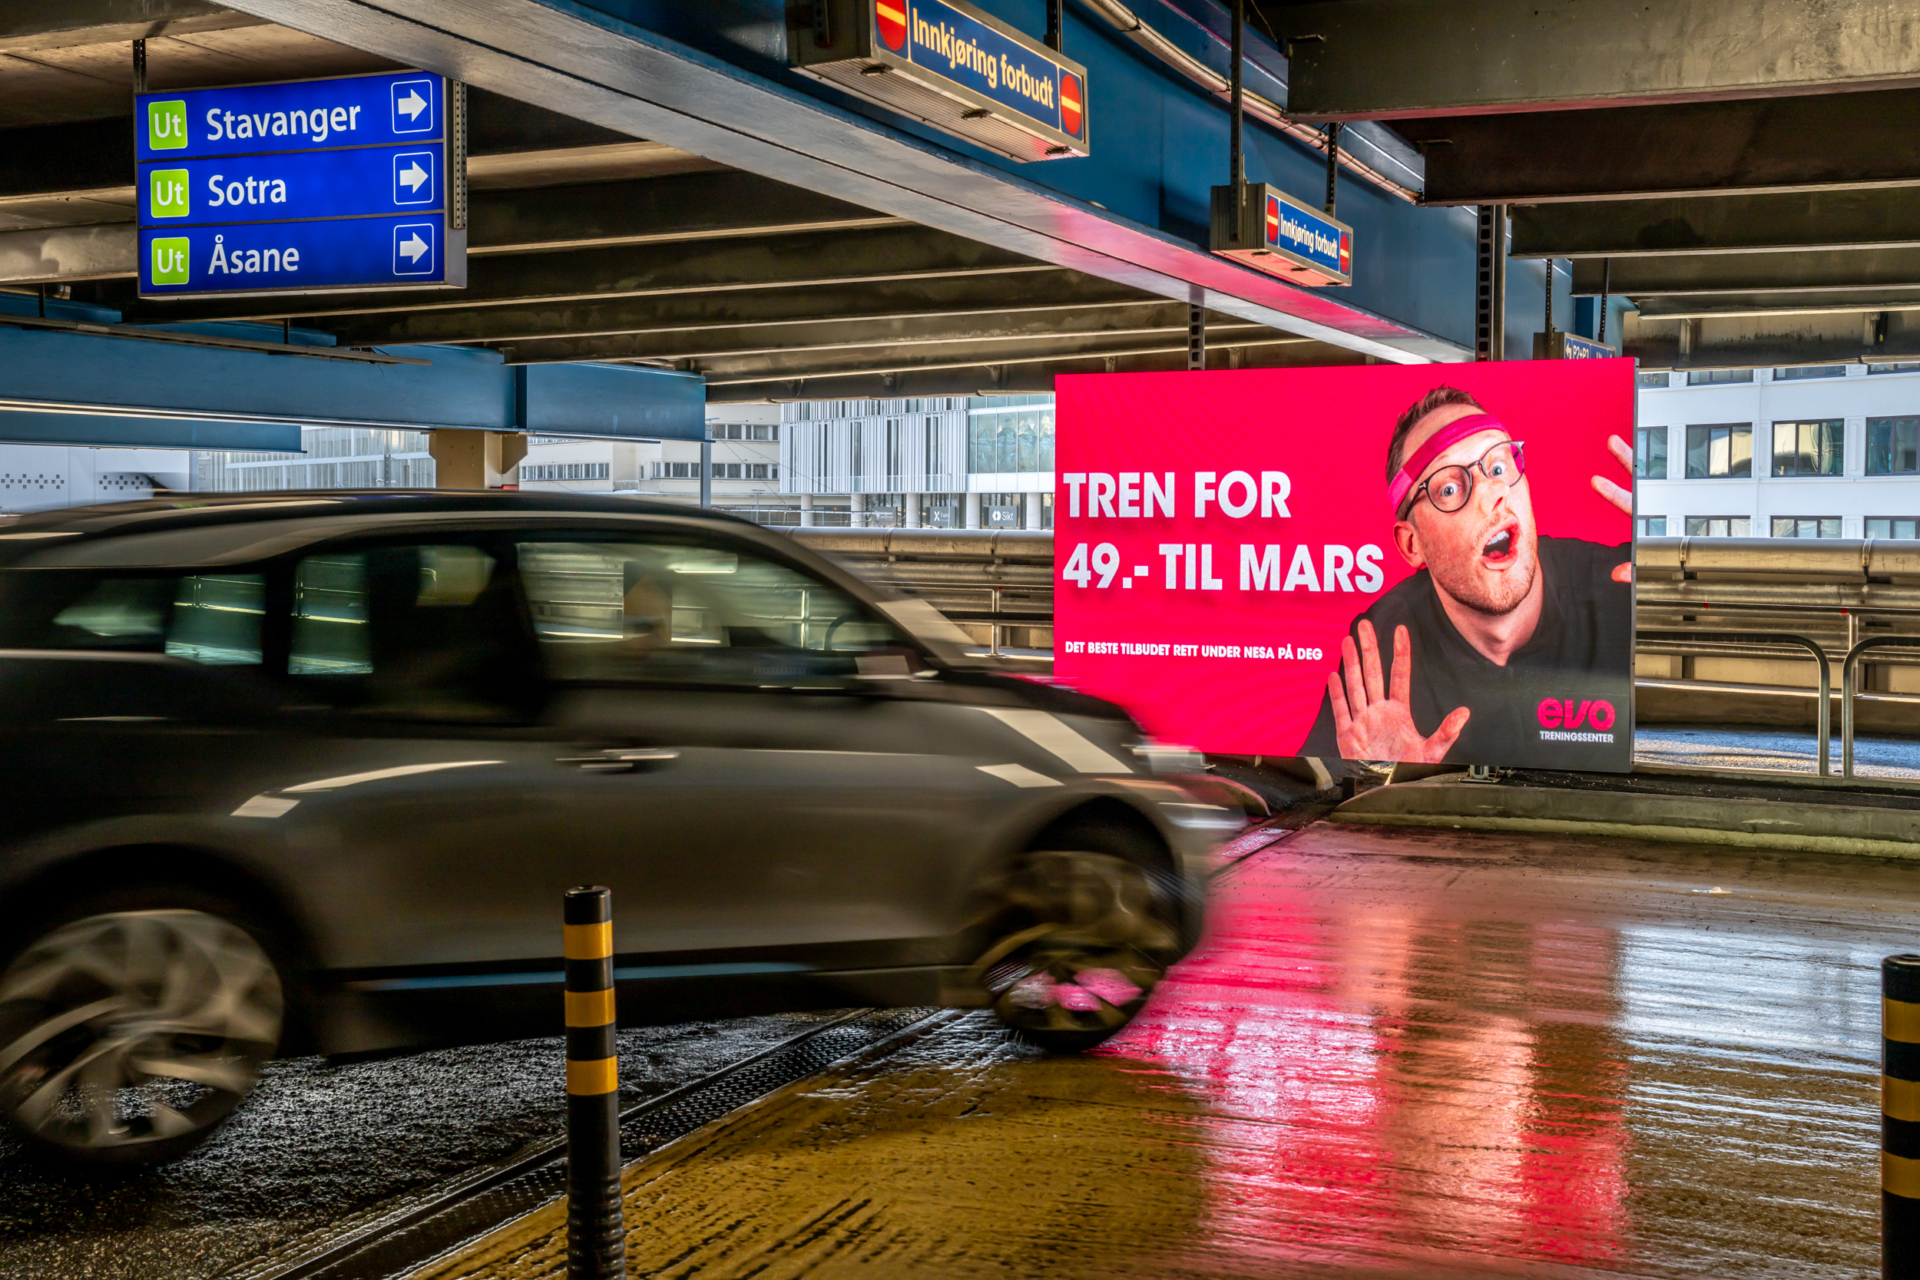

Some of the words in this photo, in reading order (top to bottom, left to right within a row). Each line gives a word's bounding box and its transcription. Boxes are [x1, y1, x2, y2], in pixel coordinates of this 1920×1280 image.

[913, 7, 998, 89] Innkjøring
[1000, 53, 1054, 109] forbudt
[154, 112, 182, 138] Ut
[206, 105, 361, 142] Stavanger
[156, 180, 184, 206] Ut
[208, 174, 287, 207] Sotra
[157, 248, 185, 274] Ut
[208, 234, 300, 275] Åsane
[1280, 213, 1314, 254] Innkjøring
[1315, 230, 1338, 259] forbudt
[1063, 472, 1175, 518] TREN
[1194, 470, 1291, 518] FOR
[1063, 542, 1149, 589] 49.-
[1159, 543, 1223, 590] TIL
[1240, 543, 1384, 593] MARS
[1065, 641, 1085, 653] DET
[1088, 642, 1118, 655] BESTE
[1120, 642, 1171, 656] TILBUDET
[1173, 644, 1199, 657] RETT
[1201, 645, 1241, 658] UNDER
[1244, 646, 1275, 659] NESA
[1278, 643, 1294, 660] PÅ
[1297, 648, 1323, 661] DEG
[1537, 697, 1616, 731] evo
[1540, 730, 1614, 743] TRENINGSSENTER
